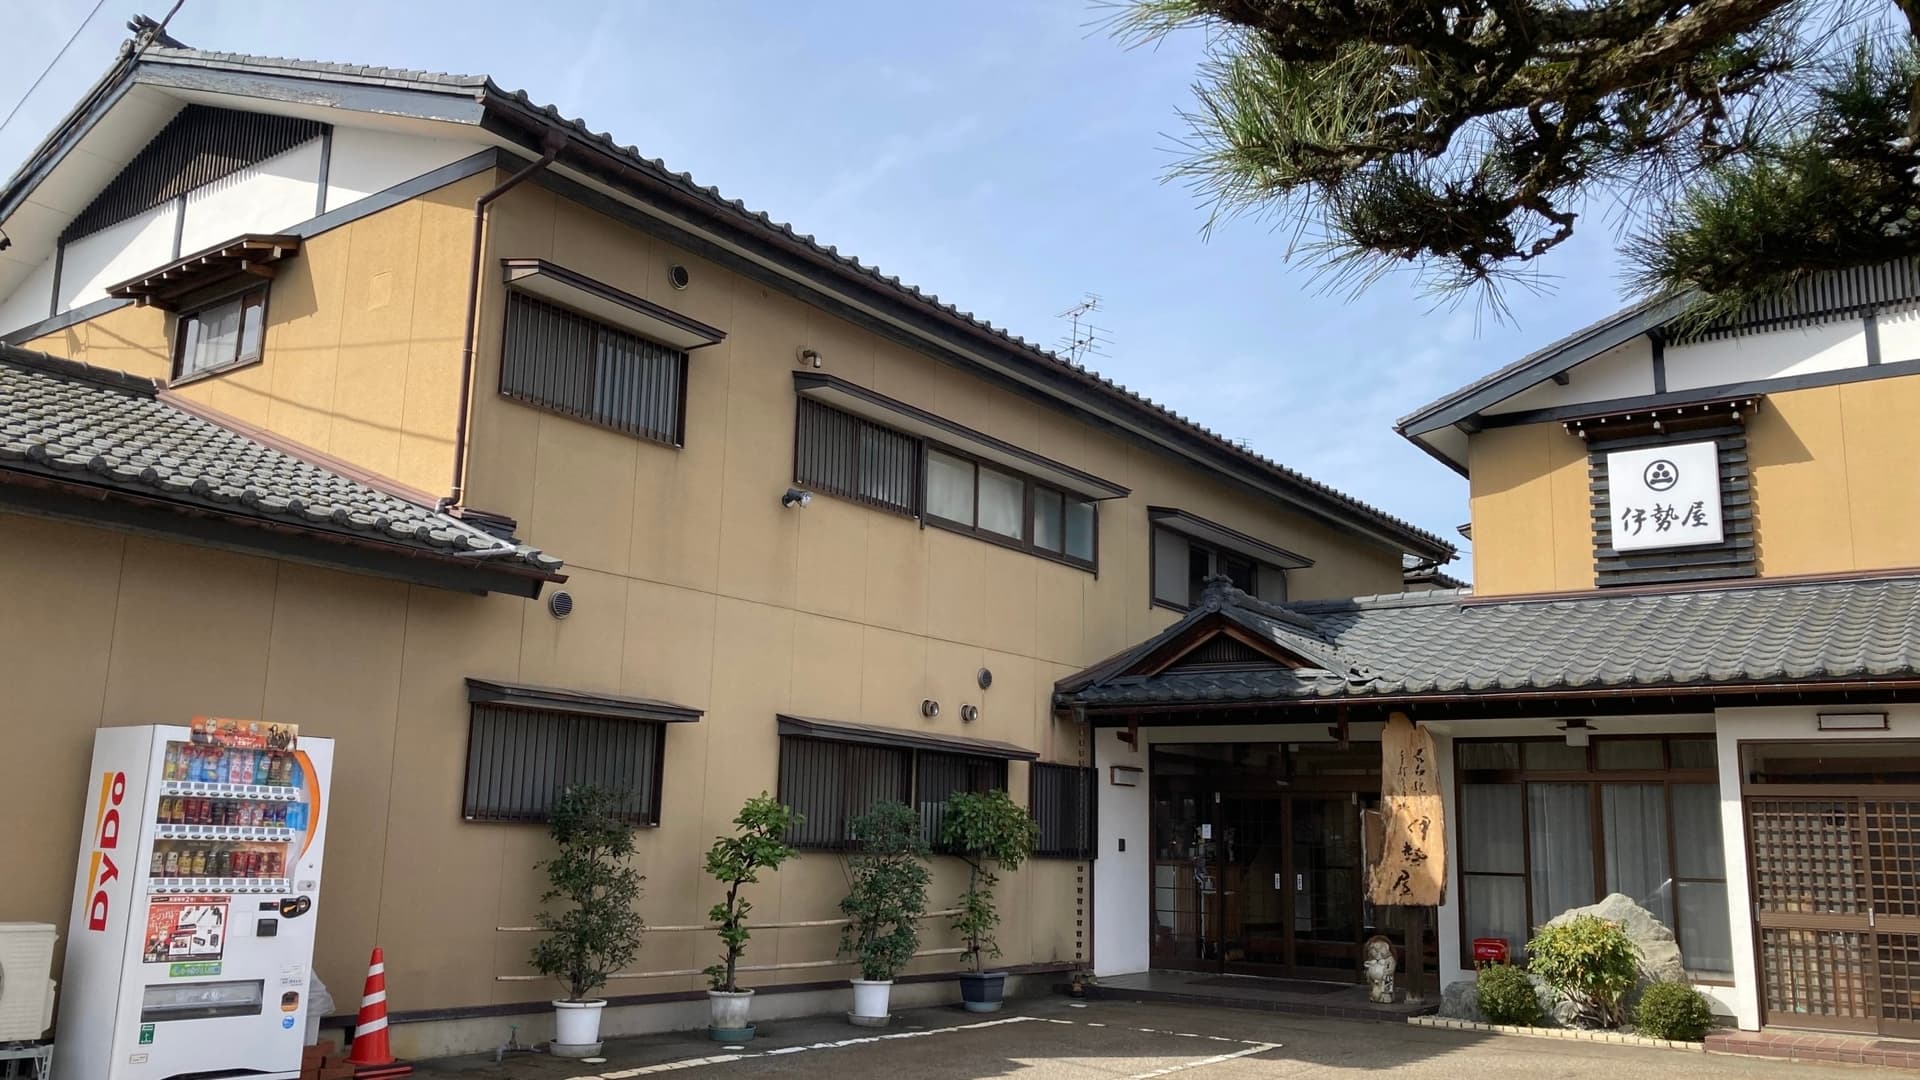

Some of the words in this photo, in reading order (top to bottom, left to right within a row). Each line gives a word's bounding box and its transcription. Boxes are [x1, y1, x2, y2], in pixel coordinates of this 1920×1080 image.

[1620, 501, 1709, 536] 伊勢屋
[1392, 815, 1431, 896] 伊勢屋
